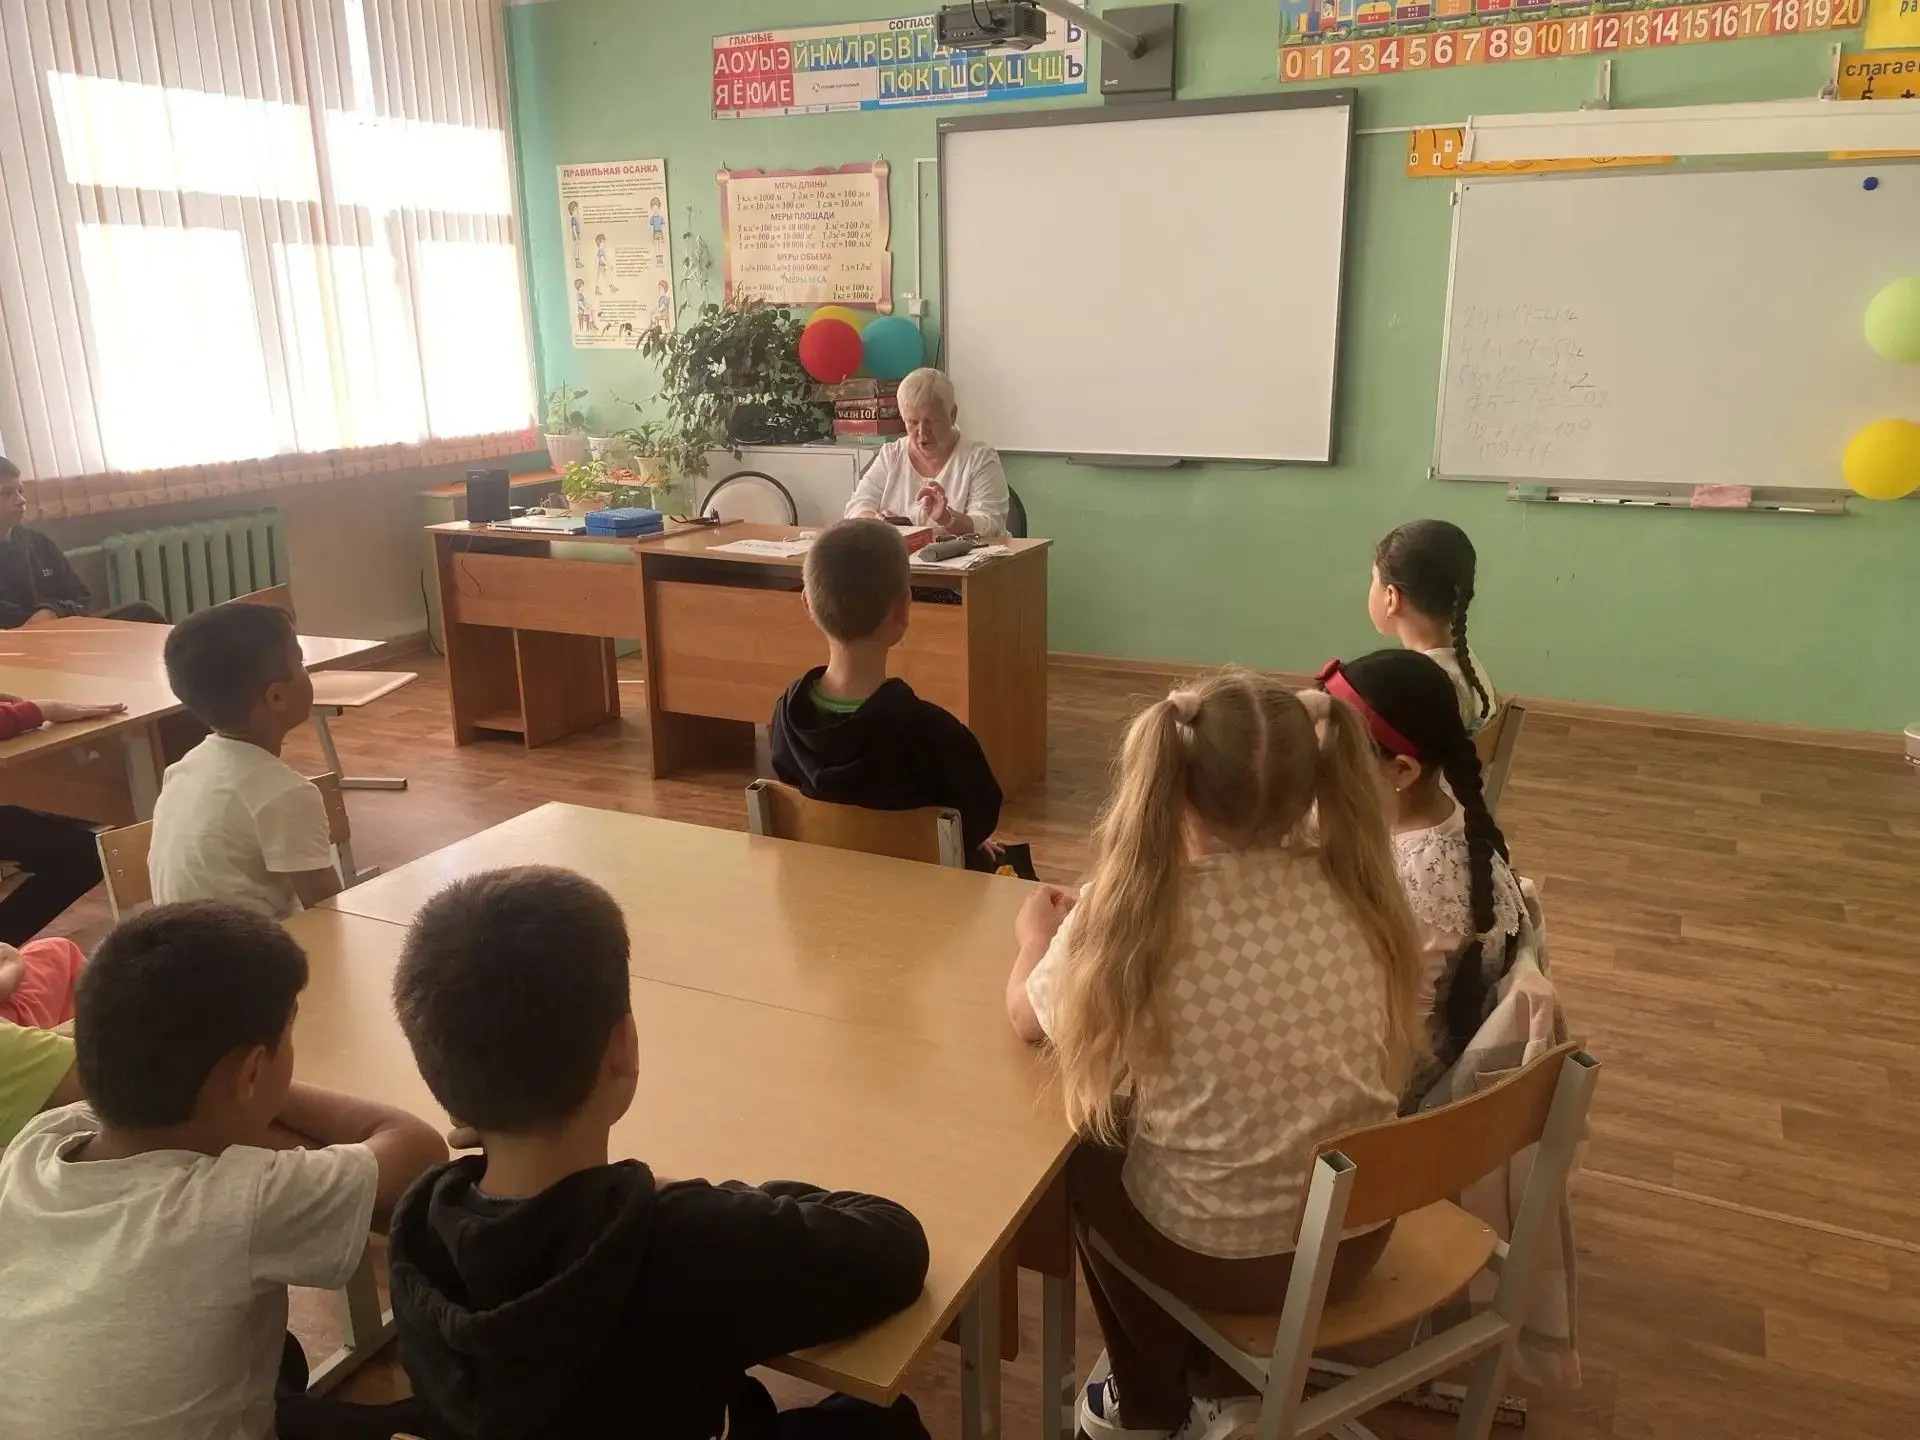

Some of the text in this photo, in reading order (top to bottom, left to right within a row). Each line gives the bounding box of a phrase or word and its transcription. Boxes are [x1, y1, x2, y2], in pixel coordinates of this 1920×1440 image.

[889, 16, 934, 31] СОГЛАС
[729, 32, 774, 46] ГЛАСНЫЕ
[1285, 0, 1862, 78] 0 1 2 3 4 5 6 7 8 9 10 11 12 13 14 15 16 17 18 19 20
[1845, 60, 1920, 77] слагае
[563, 164, 658, 178] ПРАВИЛЬНАЯ ОСАНКА
[774, 180, 828, 190] МЕРЫ ДЛИНЫ
[771, 212, 836, 221] МЕРЫ ПЛОЩАДИ
